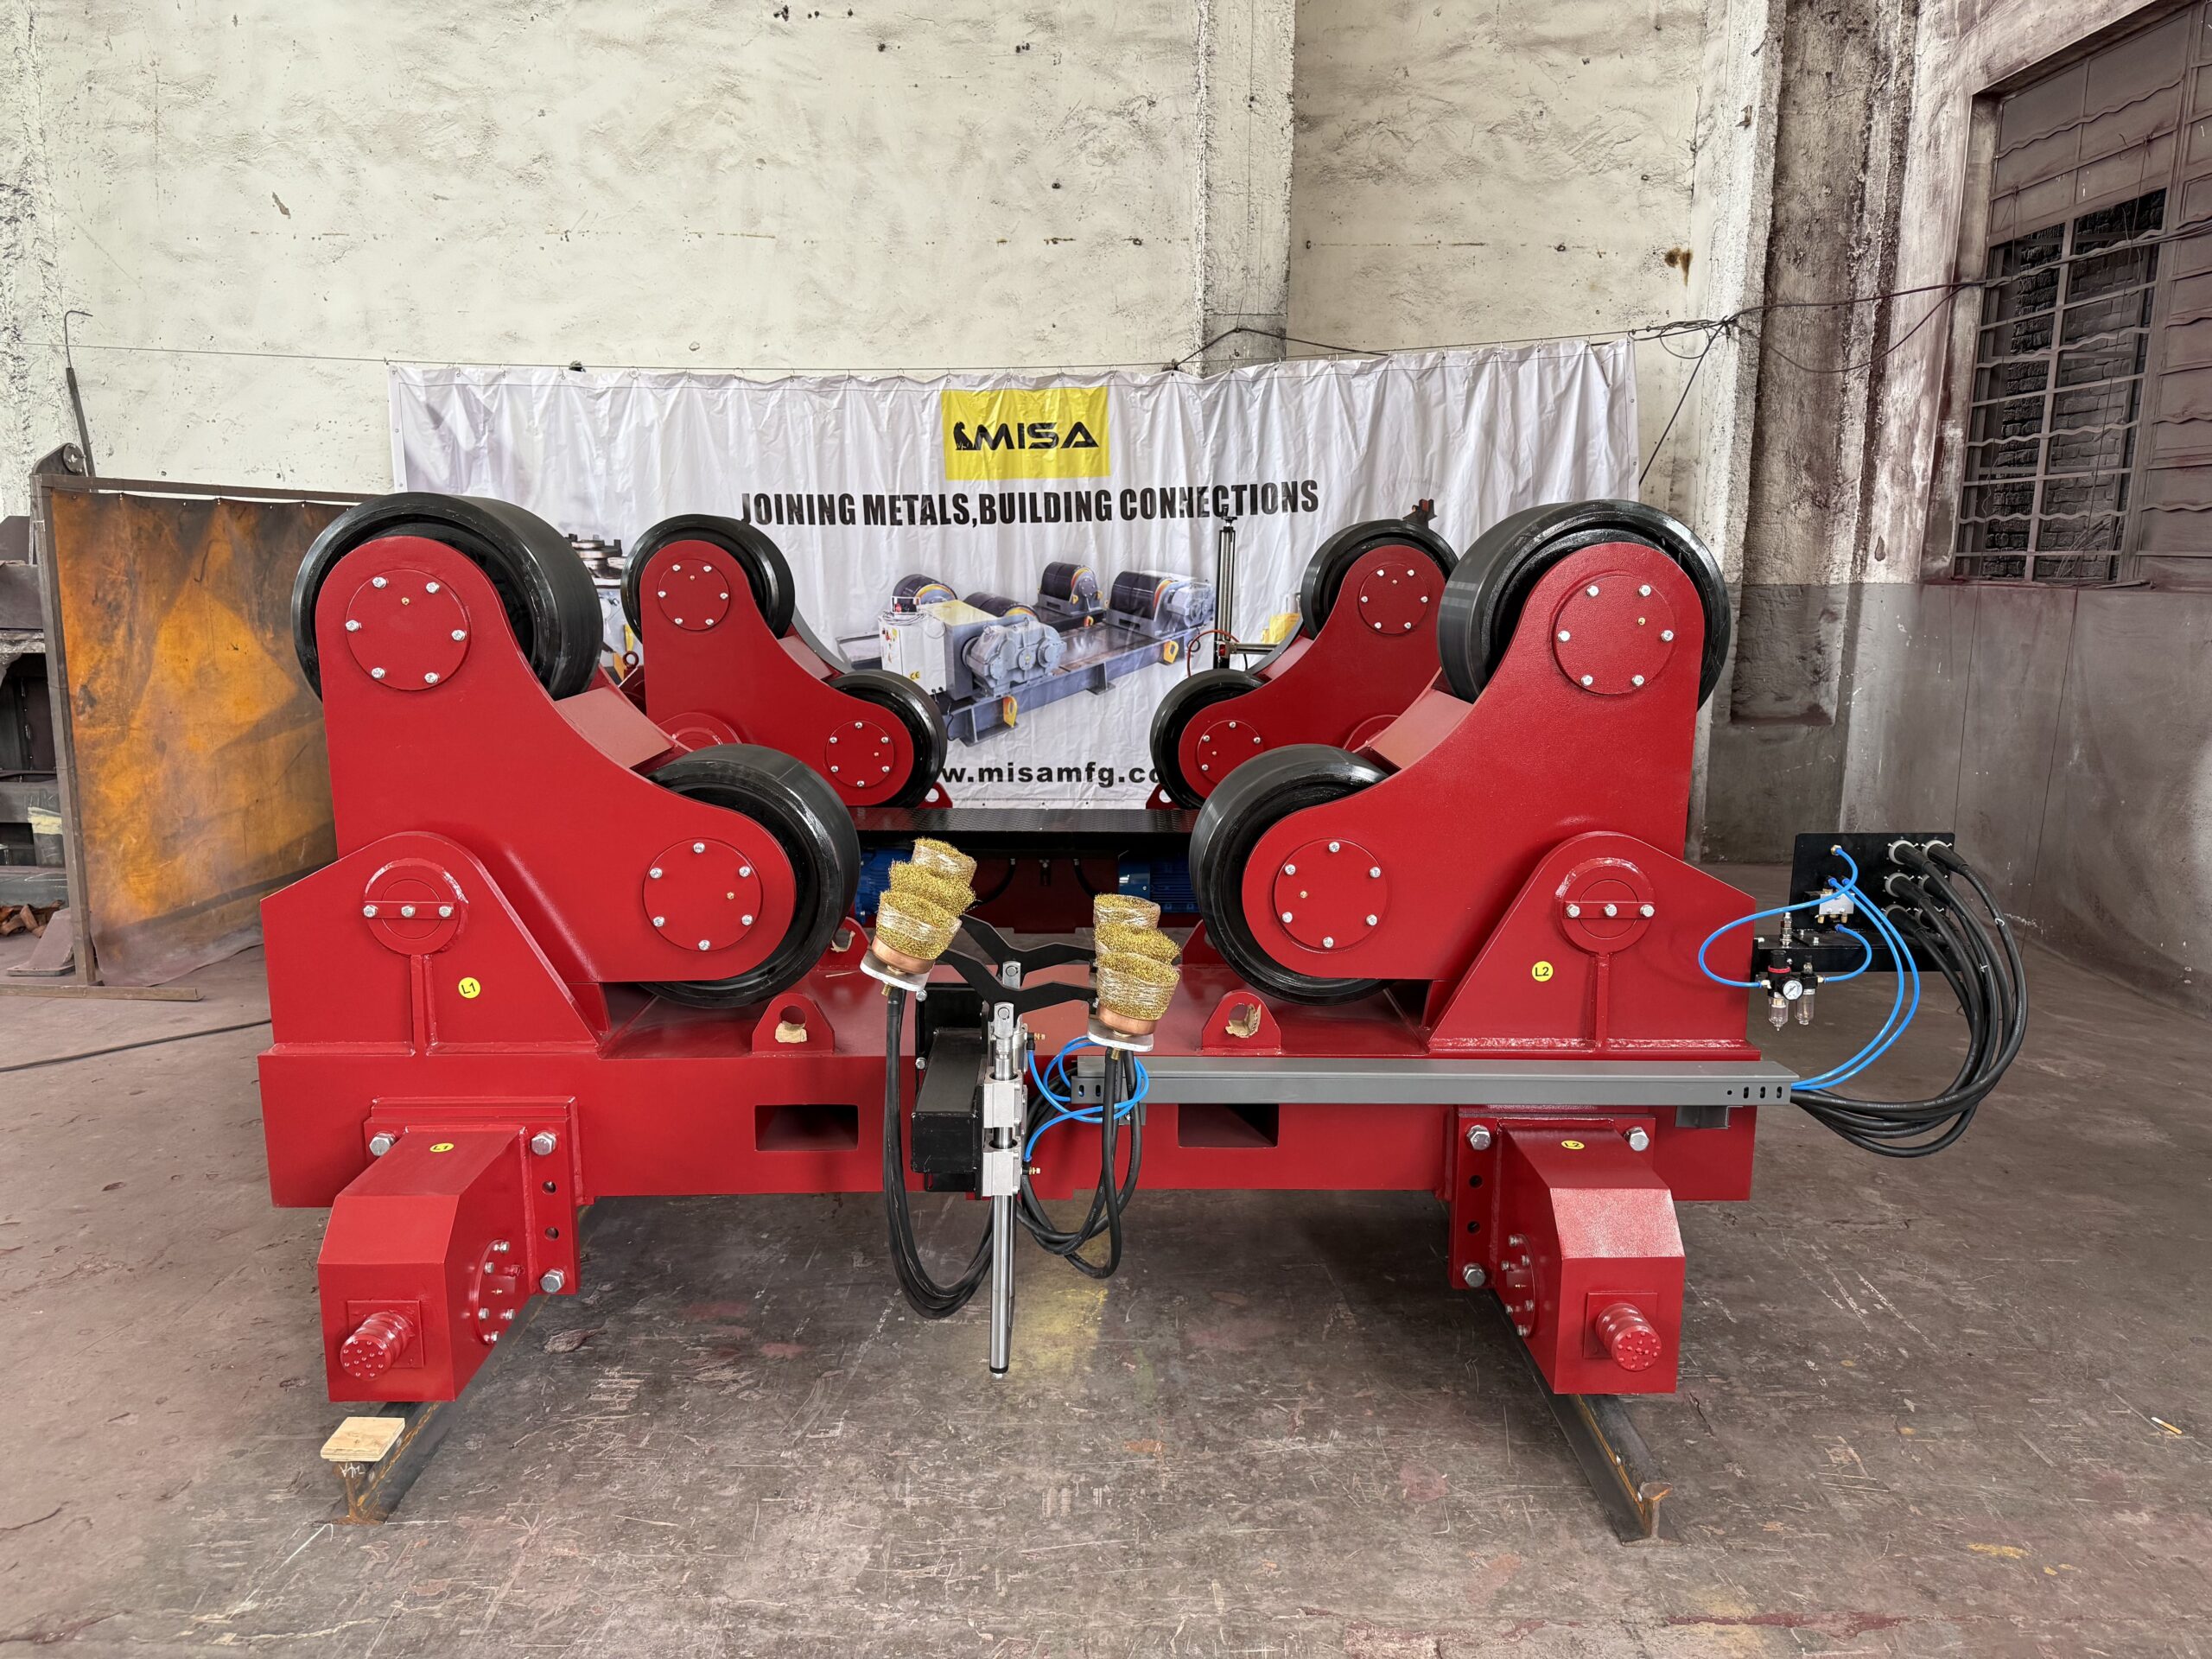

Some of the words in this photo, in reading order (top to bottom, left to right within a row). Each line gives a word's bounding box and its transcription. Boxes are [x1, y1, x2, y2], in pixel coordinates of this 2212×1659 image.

[974, 422, 1099, 450] MISA
[741, 493, 856, 525] JOINING
[1120, 480, 1319, 521] CONNECTIONS
[1535, 966, 1549, 977] L2
[461, 982, 475, 995] L1
